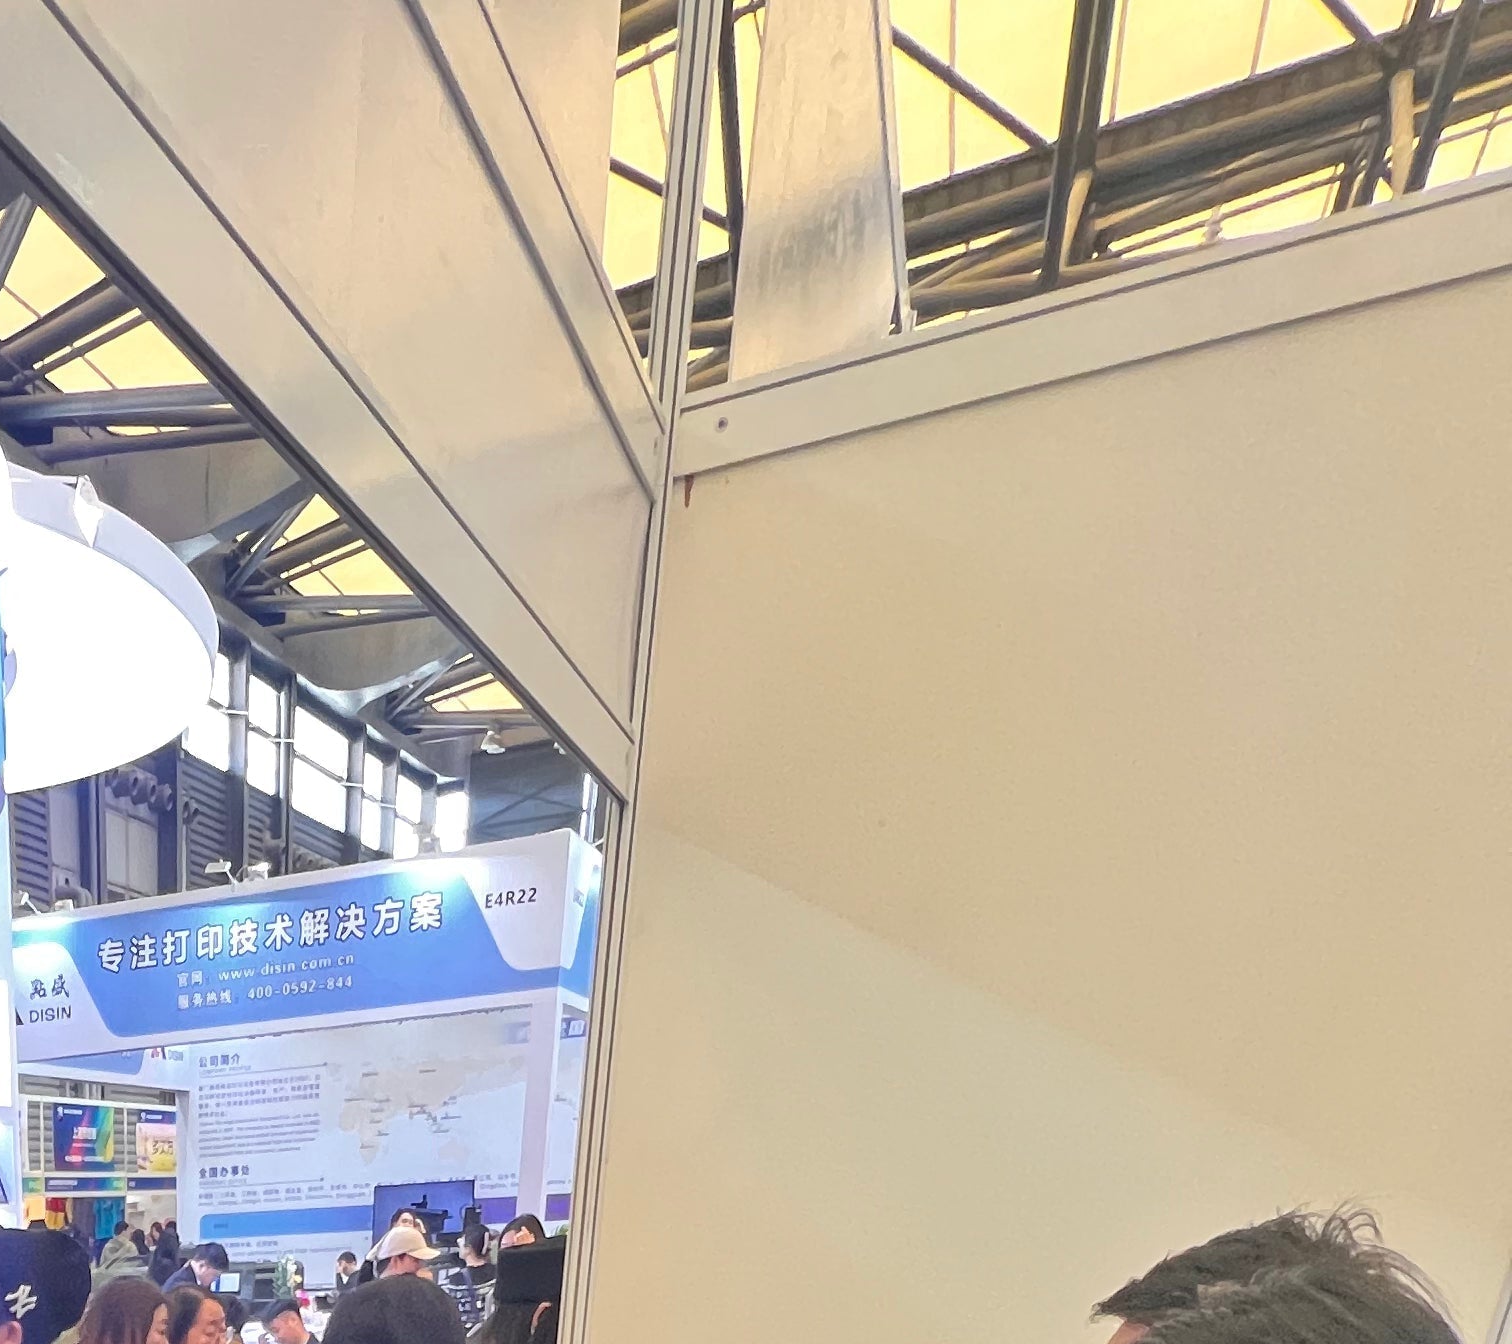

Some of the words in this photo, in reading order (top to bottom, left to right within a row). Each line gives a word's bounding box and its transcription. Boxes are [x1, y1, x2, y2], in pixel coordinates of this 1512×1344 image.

[485, 887, 537, 909] E4R22
[97, 890, 445, 974] 专注打印技术解决方案
[29, 1004, 72, 1023] DISIN
